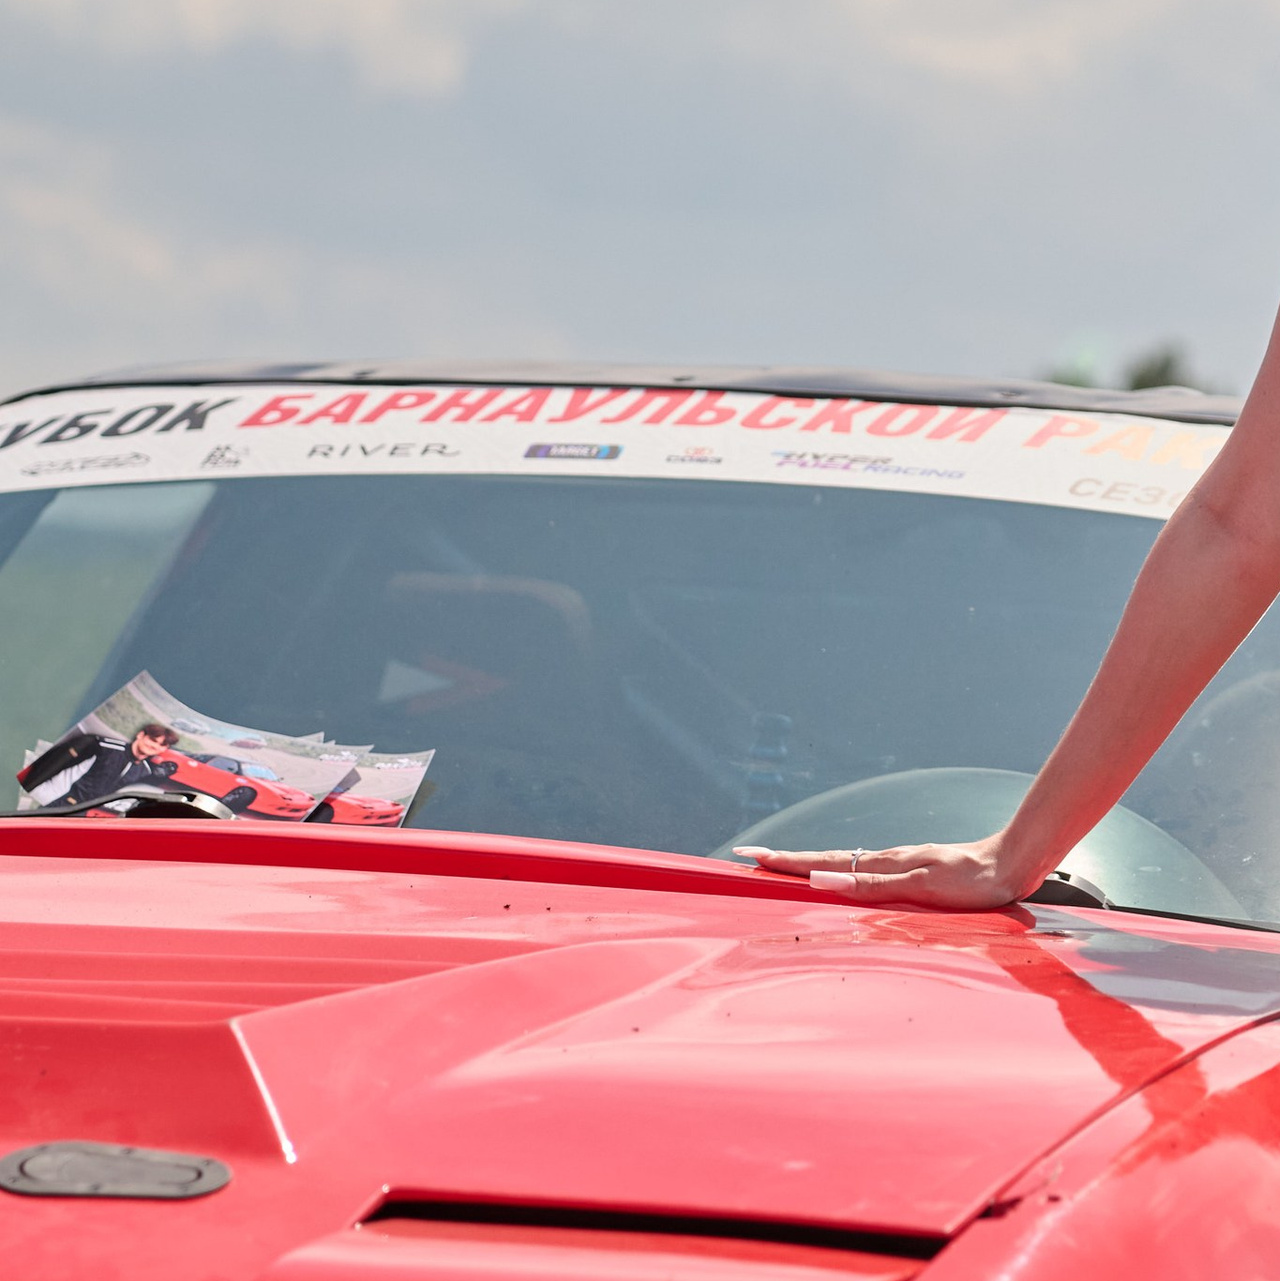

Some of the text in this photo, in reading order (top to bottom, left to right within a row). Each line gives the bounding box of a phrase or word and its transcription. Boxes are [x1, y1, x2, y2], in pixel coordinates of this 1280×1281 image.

[307, 442, 461, 459] RIVER
[783, 450, 894, 464] HYPER
[864, 463, 966, 479] RACING
[1069, 477, 1190, 509] СЕЗ
